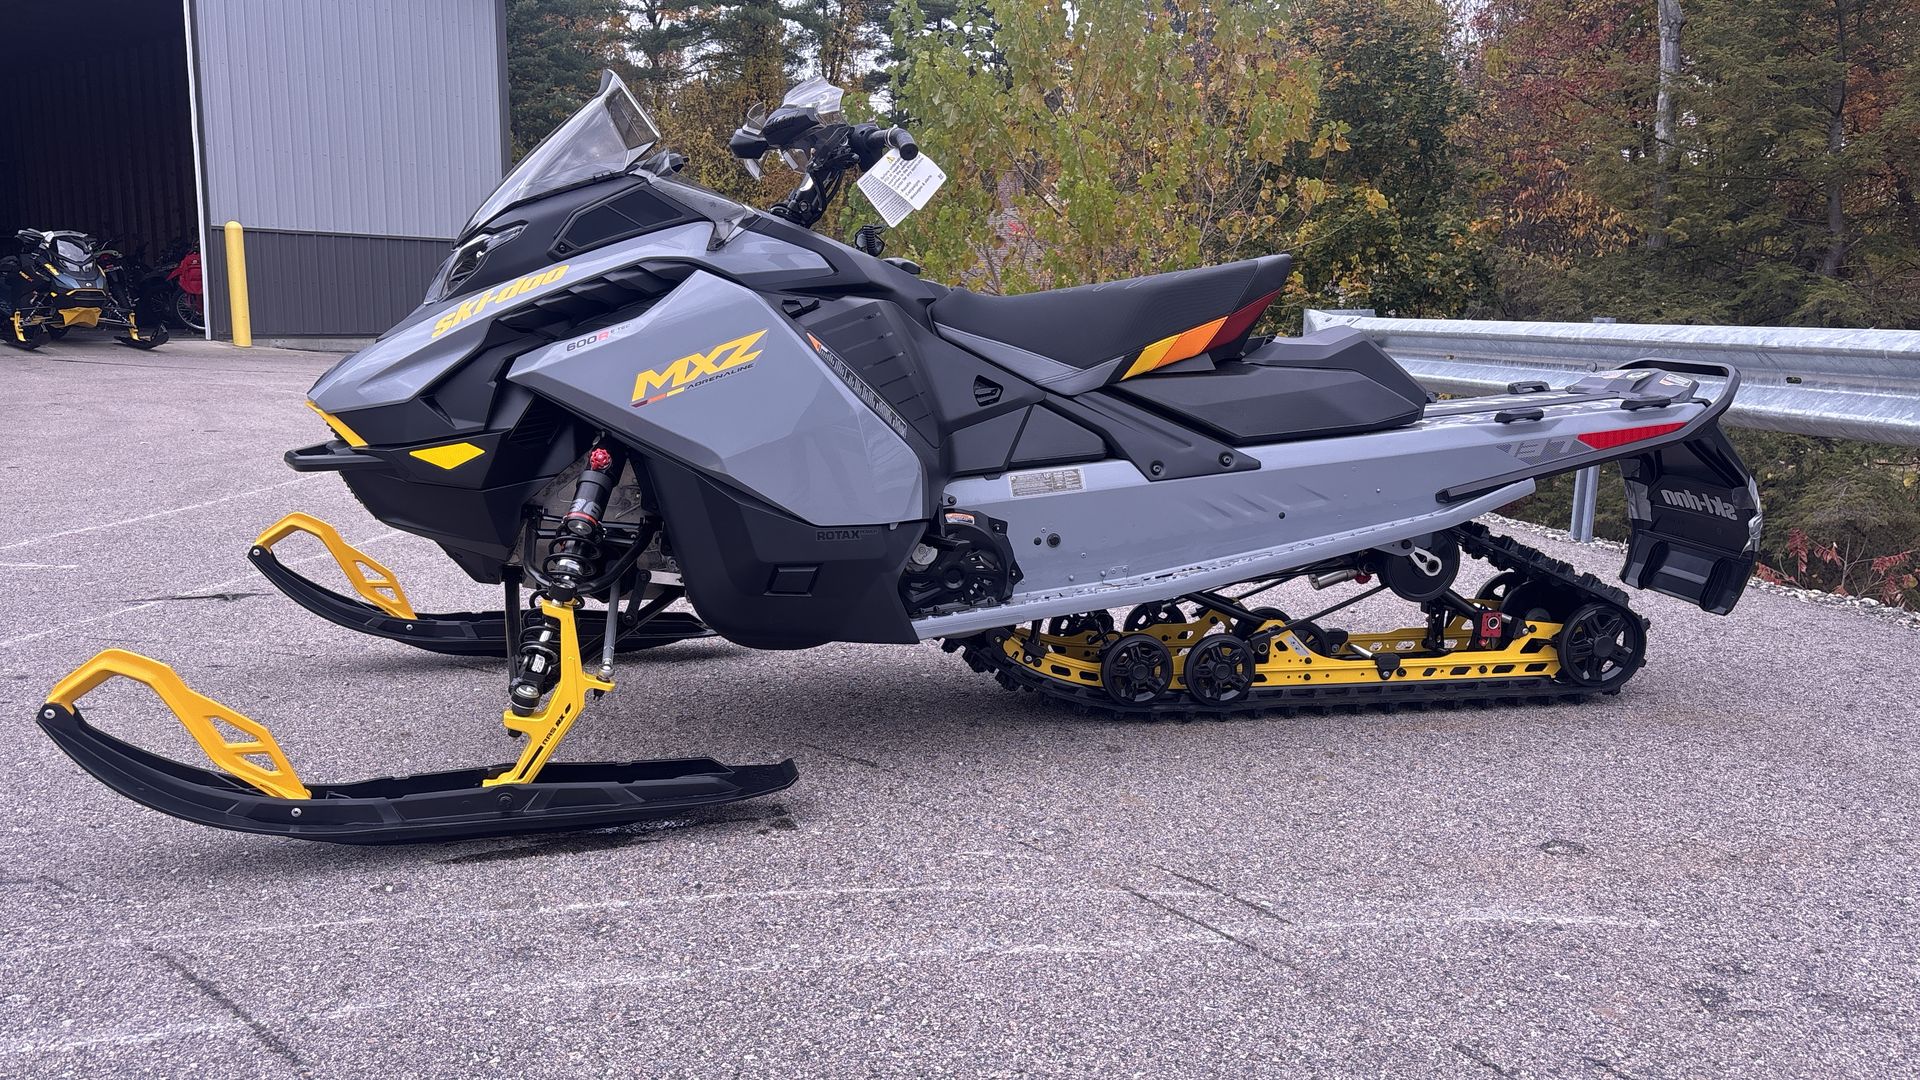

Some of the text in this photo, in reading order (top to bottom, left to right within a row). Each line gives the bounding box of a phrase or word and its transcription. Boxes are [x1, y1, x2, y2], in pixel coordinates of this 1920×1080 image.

[431, 264, 570, 338] ski-doo
[566, 331, 609, 352] 600R
[631, 329, 769, 402] MXZ
[686, 363, 754, 390] ADRENALINE
[816, 529, 861, 541] ROTAX
